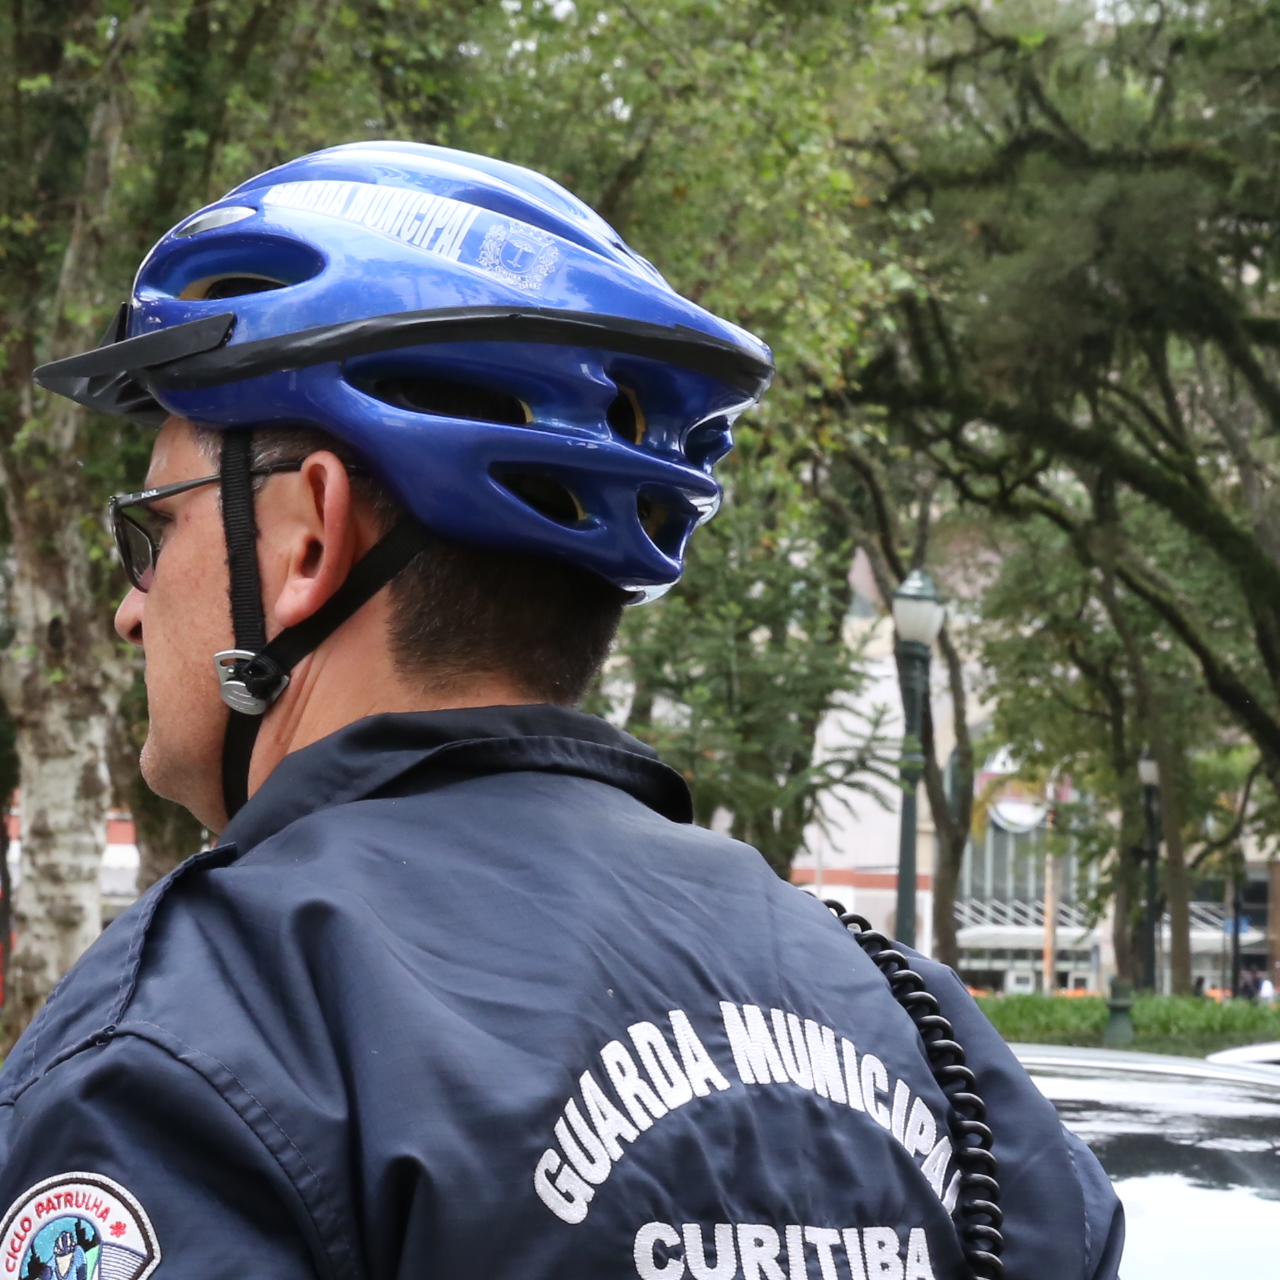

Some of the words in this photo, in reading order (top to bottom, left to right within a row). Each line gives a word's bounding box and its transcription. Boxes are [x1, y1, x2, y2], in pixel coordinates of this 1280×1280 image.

[266, 183, 353, 218] GUARDA
[344, 184, 482, 262] MUNICIPAL
[534, 1010, 731, 1225] GUARDA
[5, 1217, 32, 1273] CICLO
[35, 1191, 111, 1223] PATRULHA
